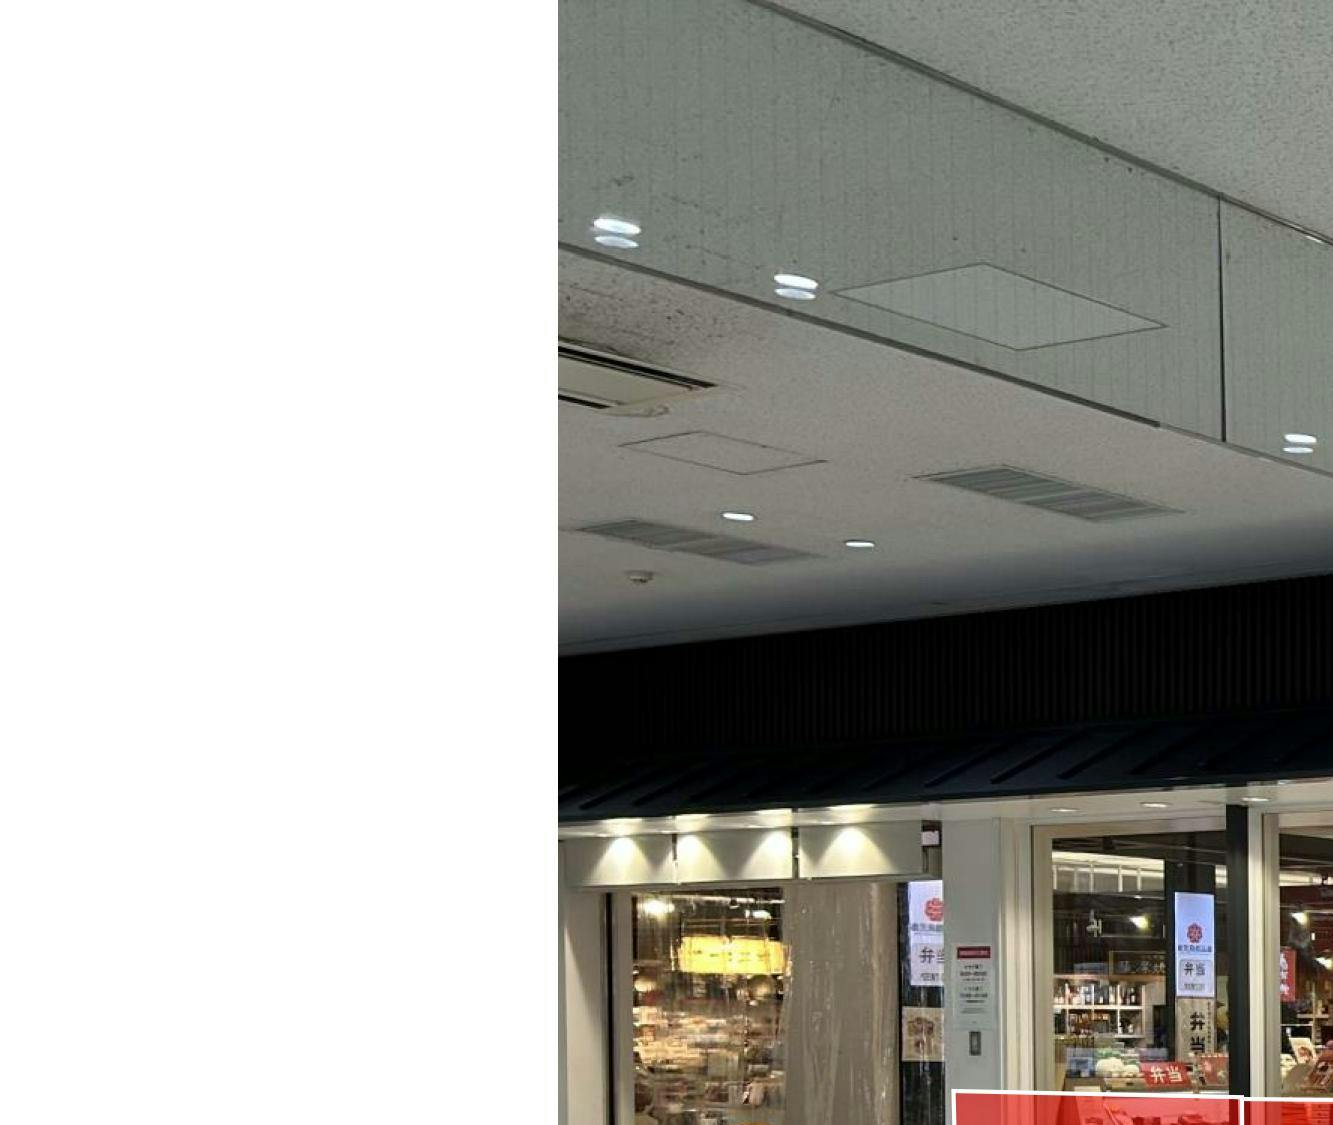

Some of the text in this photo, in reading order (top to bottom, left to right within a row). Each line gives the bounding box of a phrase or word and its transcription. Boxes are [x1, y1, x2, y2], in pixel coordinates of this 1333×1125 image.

[1184, 961, 1205, 976] 弁当
[1189, 1011, 1206, 1055] 弁当
[1149, 1066, 1183, 1084] 弁当
